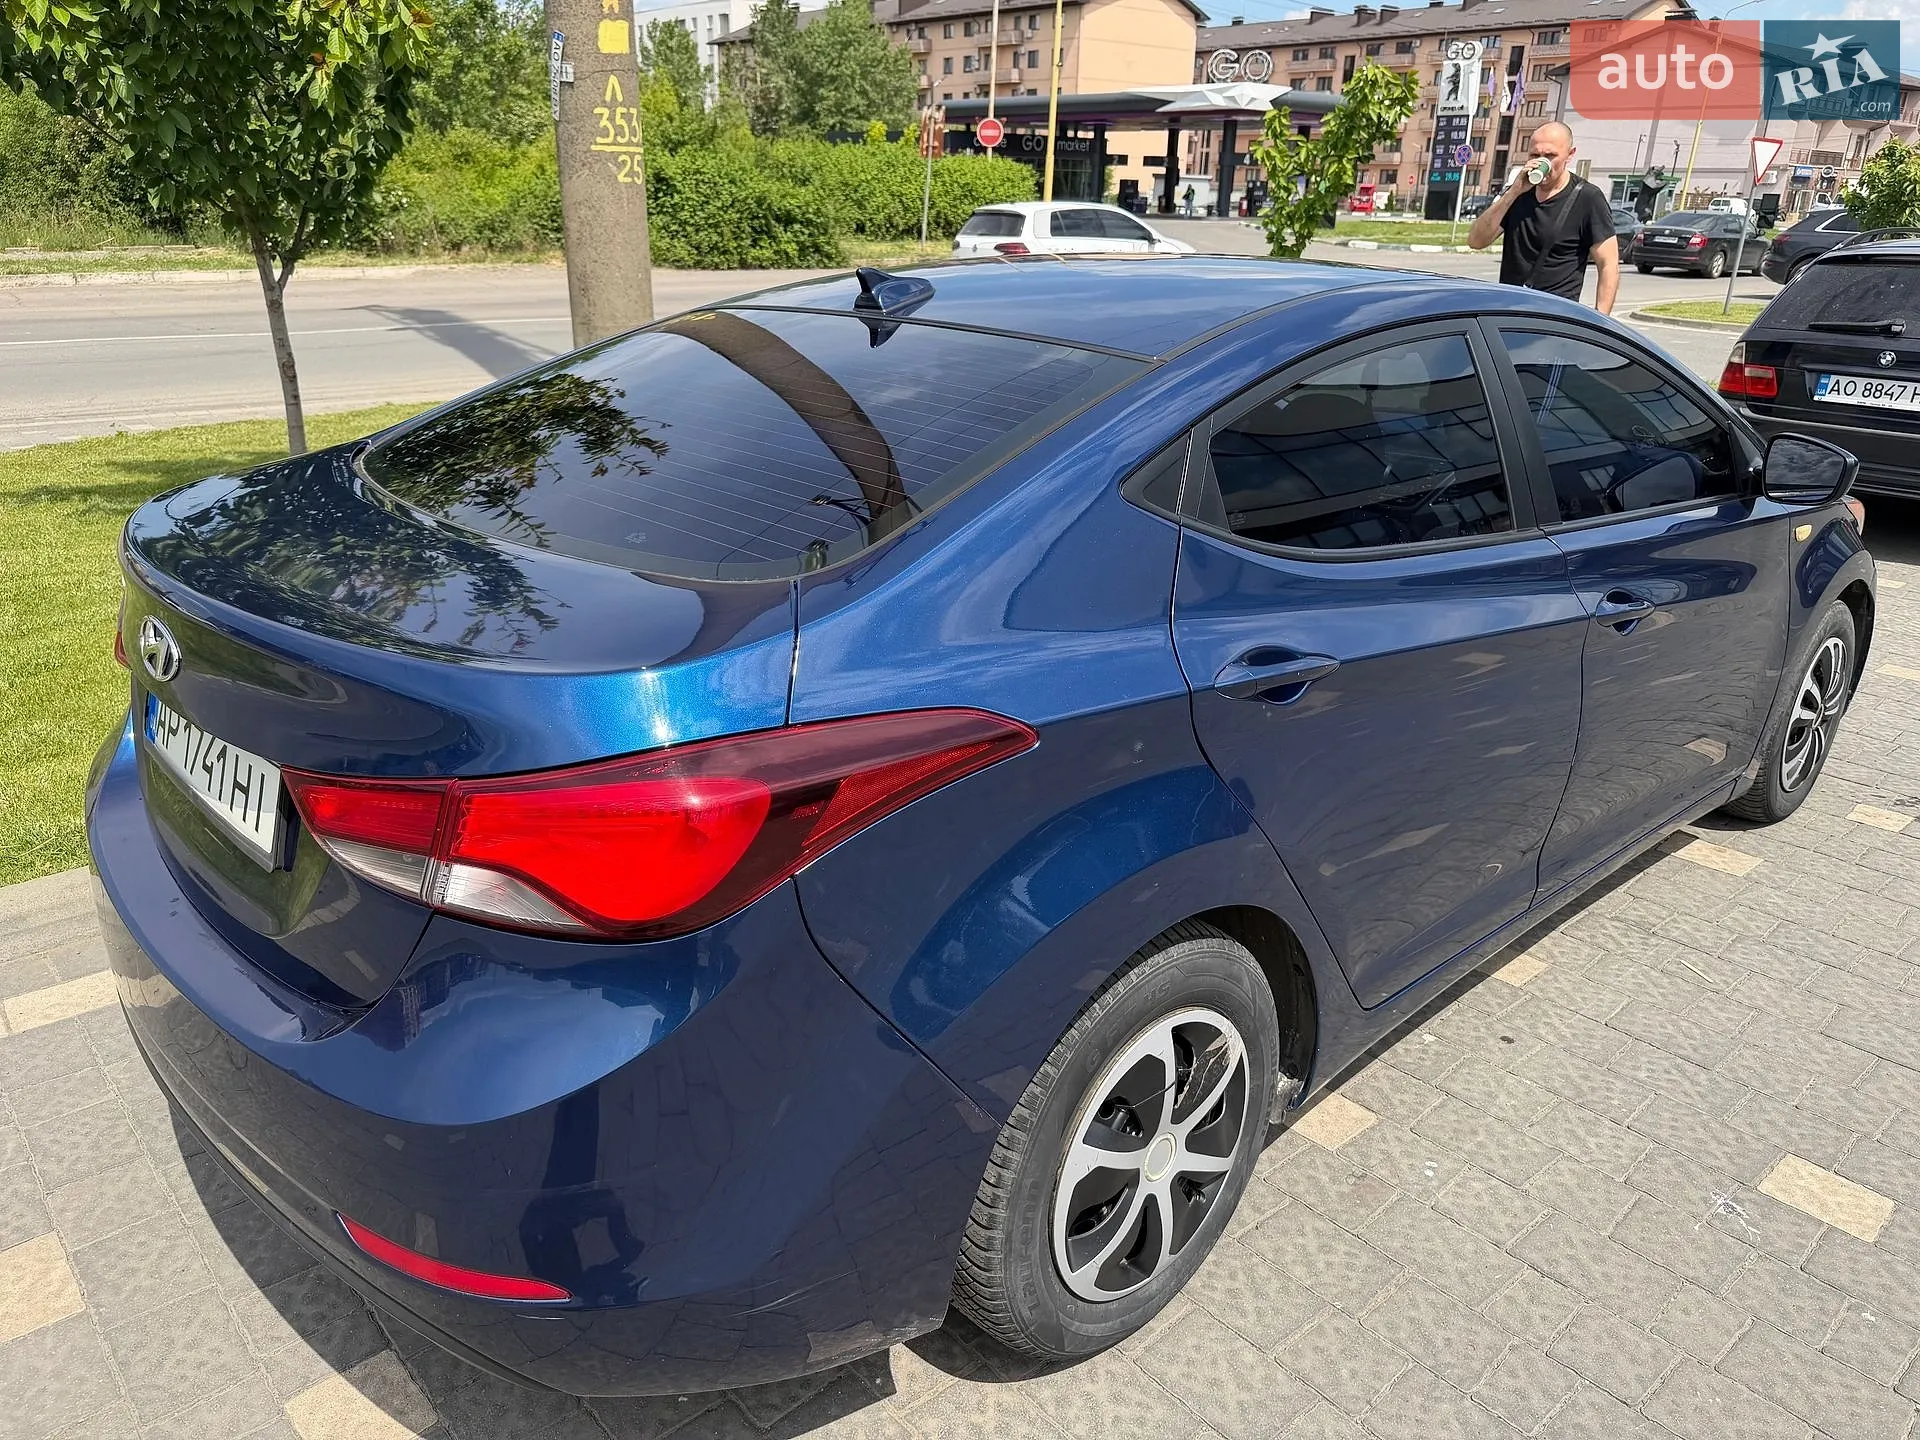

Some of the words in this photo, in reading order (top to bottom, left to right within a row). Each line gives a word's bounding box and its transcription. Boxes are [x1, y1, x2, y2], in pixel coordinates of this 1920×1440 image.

[1446, 42, 1477, 60] GO
[1207, 48, 1273, 84] GO
[1022, 136, 1044, 151] GO
[1057, 139, 1090, 152] market
[616, 154, 643, 185] 25
[1827, 378, 1857, 397] AO
[1861, 382, 1908, 402] 8847
